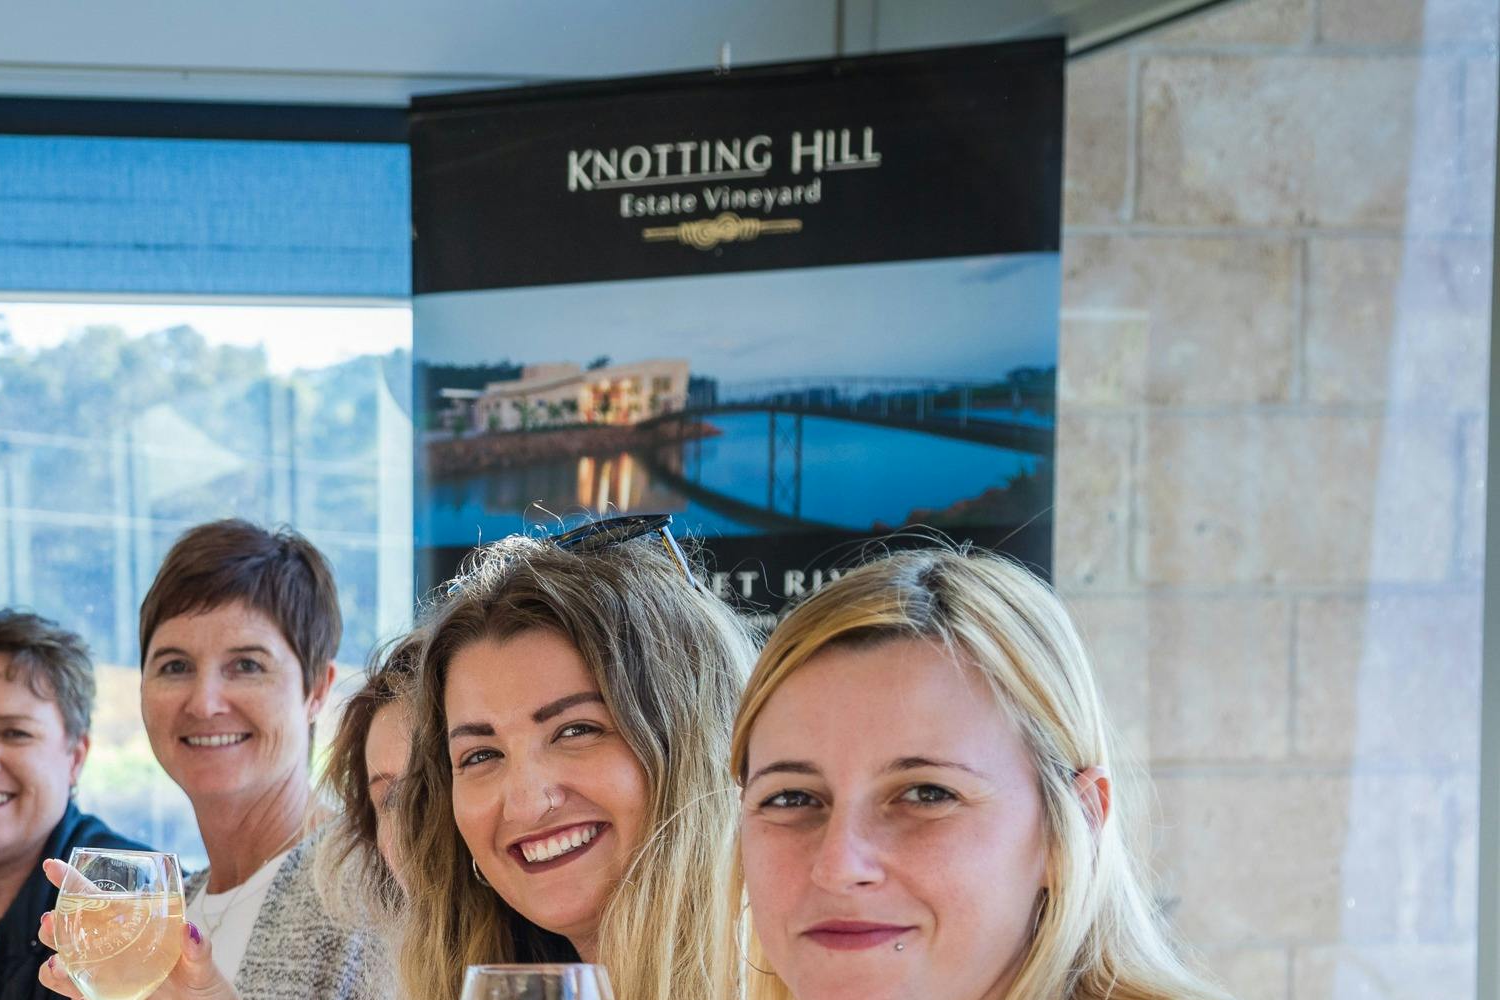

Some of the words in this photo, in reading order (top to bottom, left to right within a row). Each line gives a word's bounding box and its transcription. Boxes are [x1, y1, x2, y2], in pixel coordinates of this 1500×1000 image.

[567, 134, 773, 192] KNOTTING
[791, 126, 883, 175] HILL
[619, 191, 698, 218] Estate
[702, 176, 823, 214] Vineyard
[710, 570, 761, 599] ET
